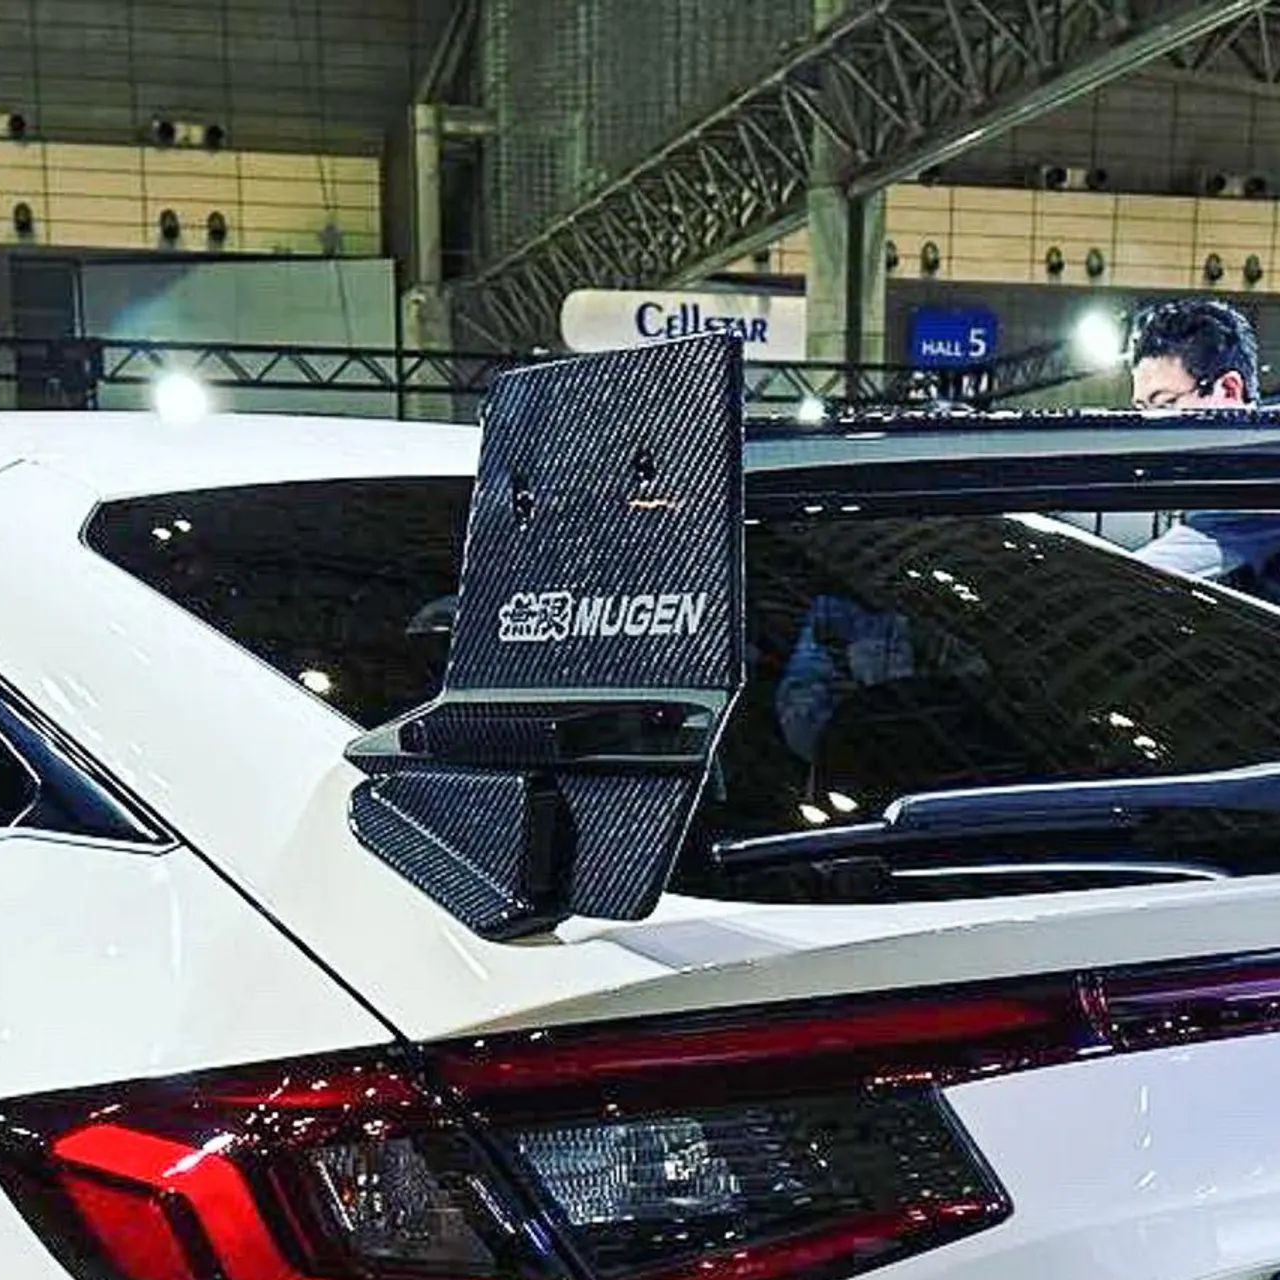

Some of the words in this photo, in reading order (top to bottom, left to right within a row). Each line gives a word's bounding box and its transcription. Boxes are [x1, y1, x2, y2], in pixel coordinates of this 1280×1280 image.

[921, 338, 962, 357] HALL
[968, 327, 987, 357] 5
[572, 592, 708, 637] MUGEN
